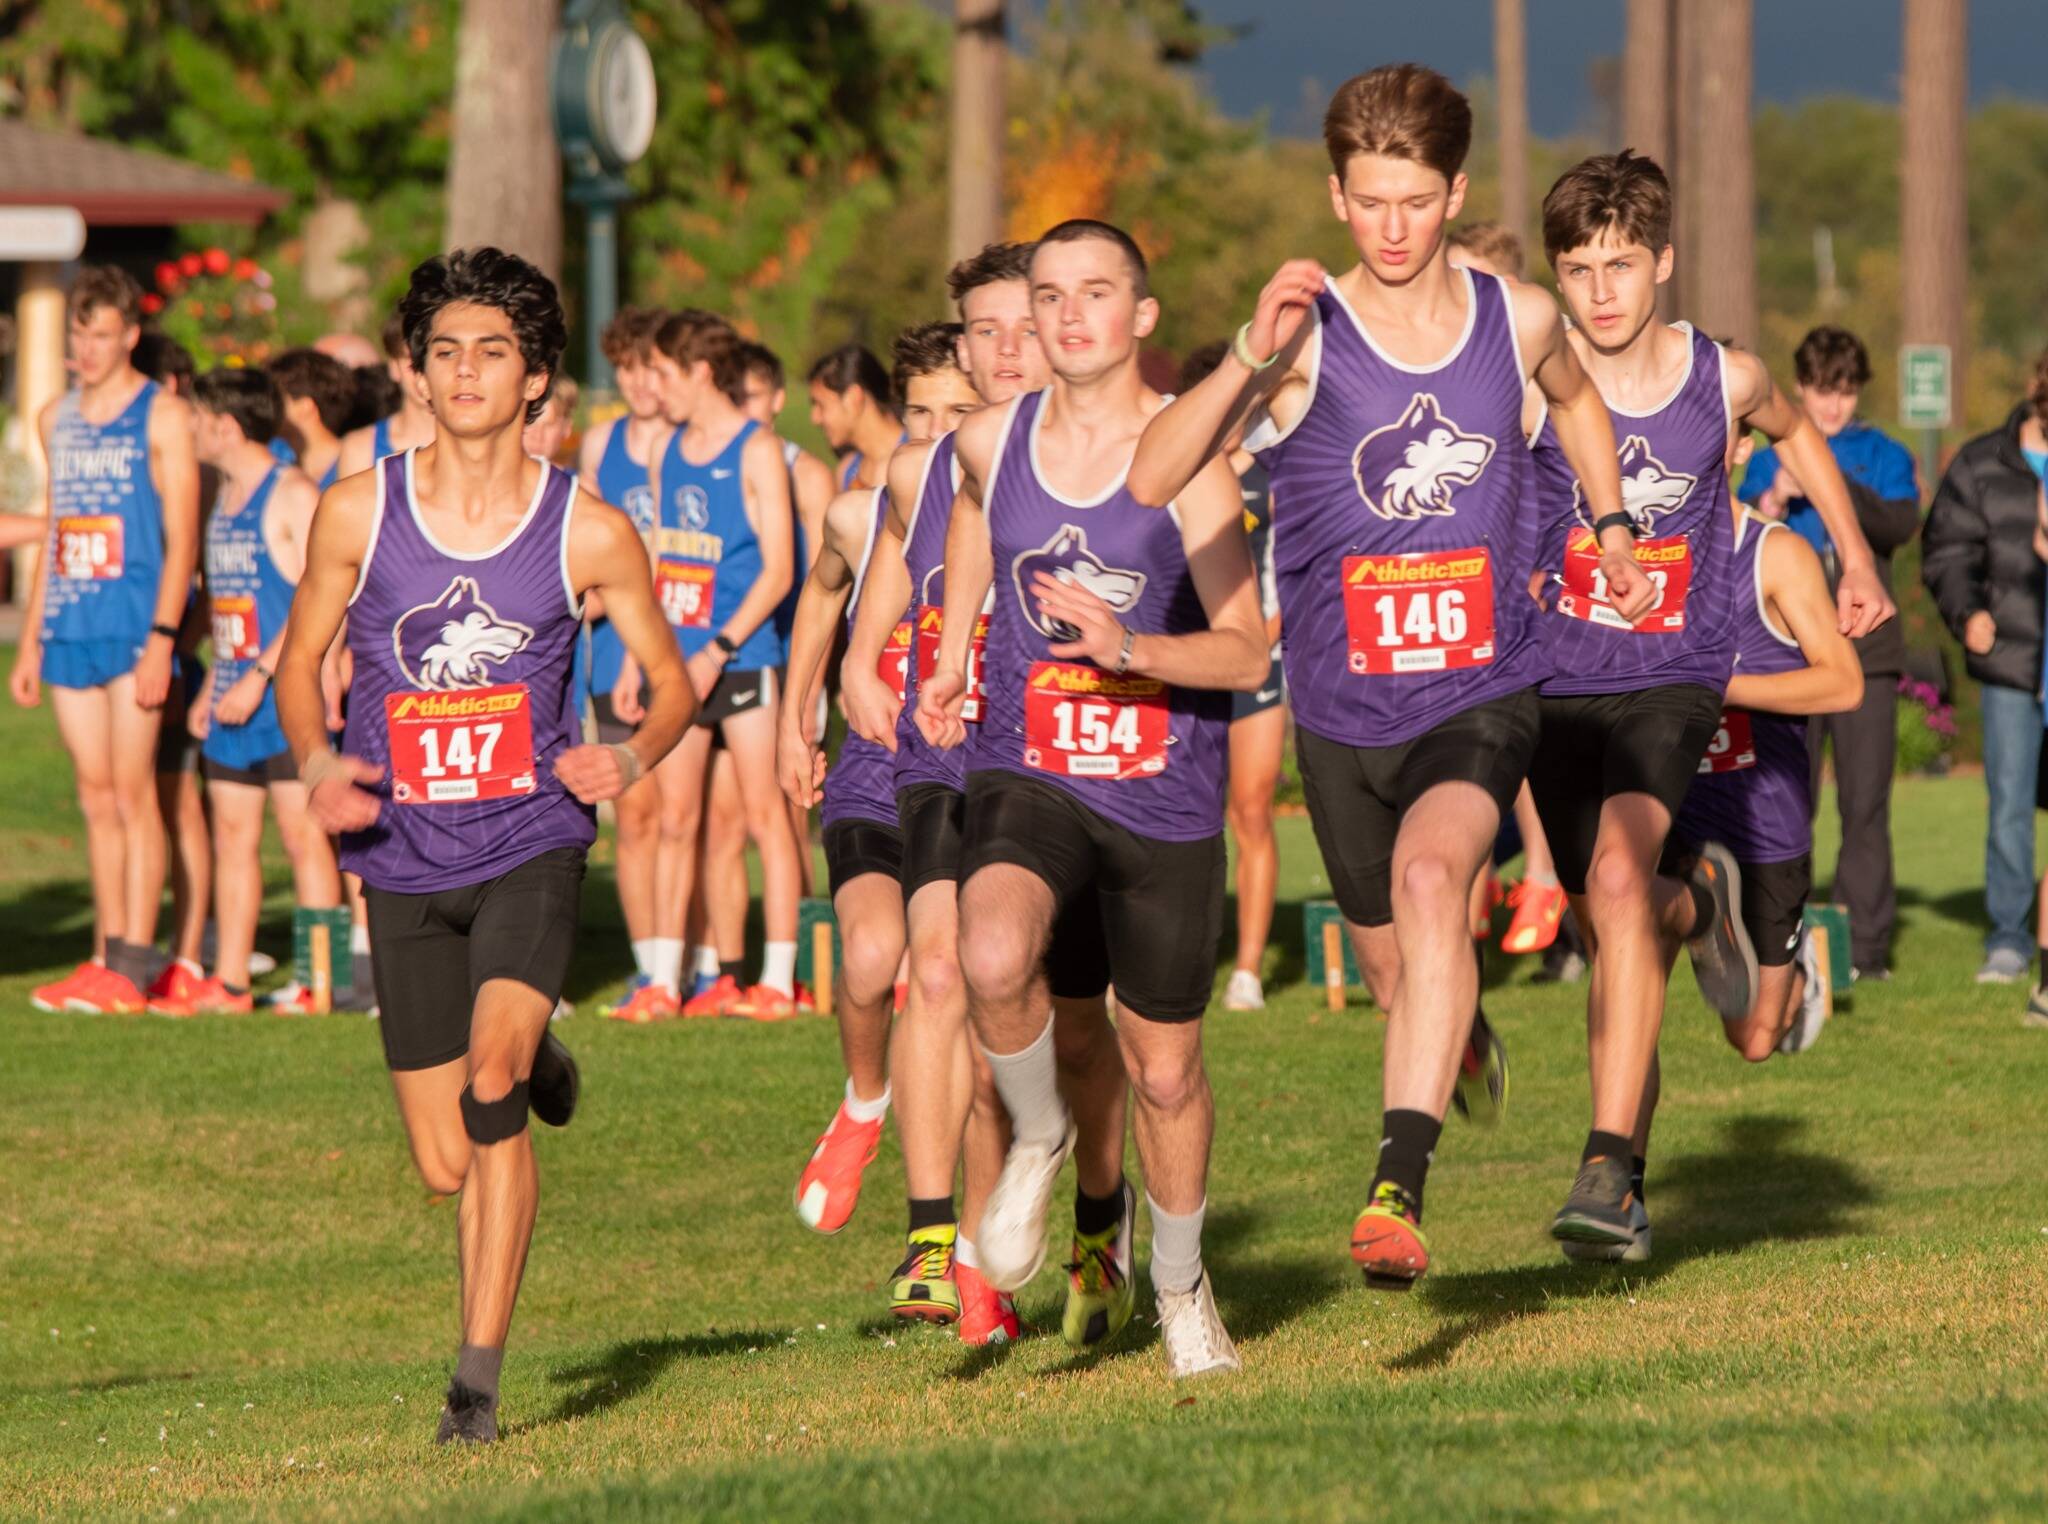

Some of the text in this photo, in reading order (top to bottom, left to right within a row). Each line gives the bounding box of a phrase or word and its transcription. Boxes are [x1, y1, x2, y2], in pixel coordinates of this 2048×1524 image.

[1588, 568, 1668, 610] 13
[1375, 588, 1468, 647] 146
[418, 722, 503, 777] 147
[1051, 701, 1142, 754] 154
